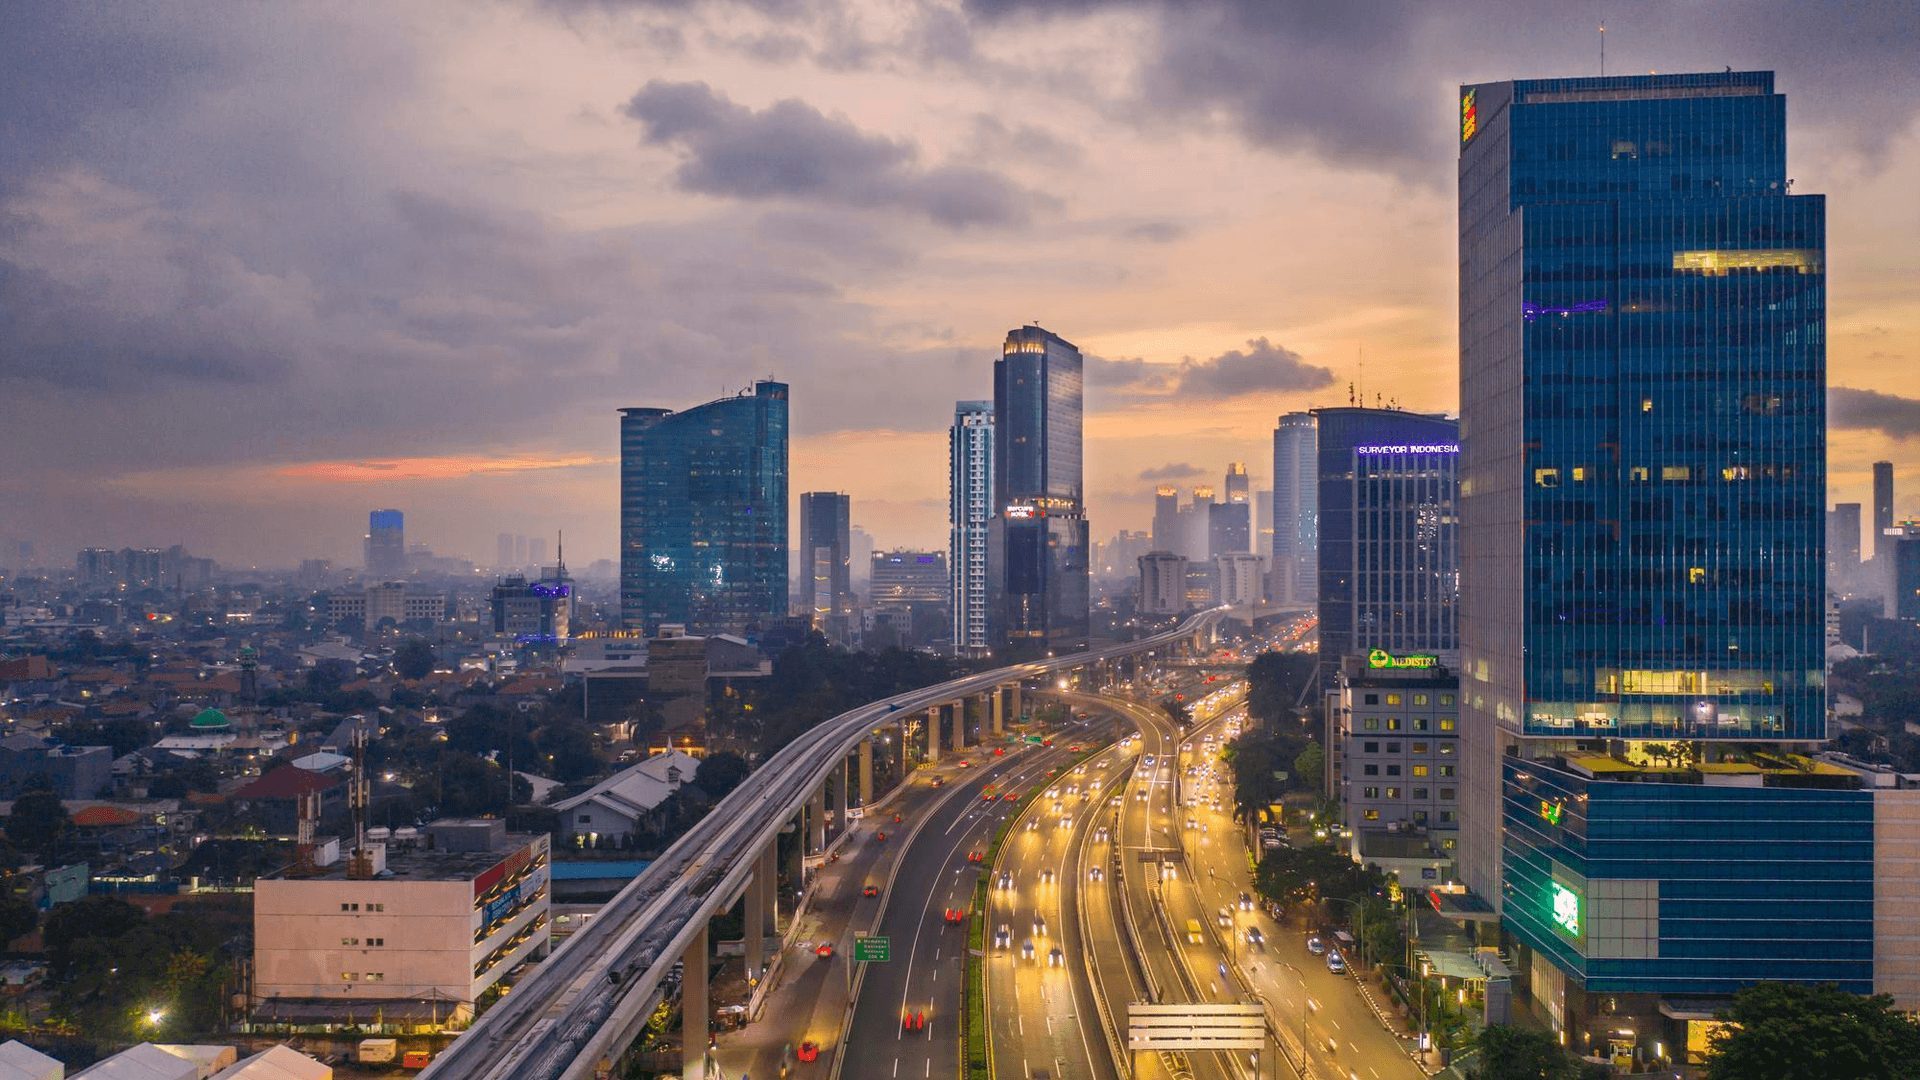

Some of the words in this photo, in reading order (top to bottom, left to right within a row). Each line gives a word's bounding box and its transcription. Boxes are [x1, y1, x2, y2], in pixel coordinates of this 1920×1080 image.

[1359, 445, 1407, 454] SURVEYOR
[1410, 444, 1459, 453] INDONESIA
[1391, 657, 1438, 666] MEDISTRA
